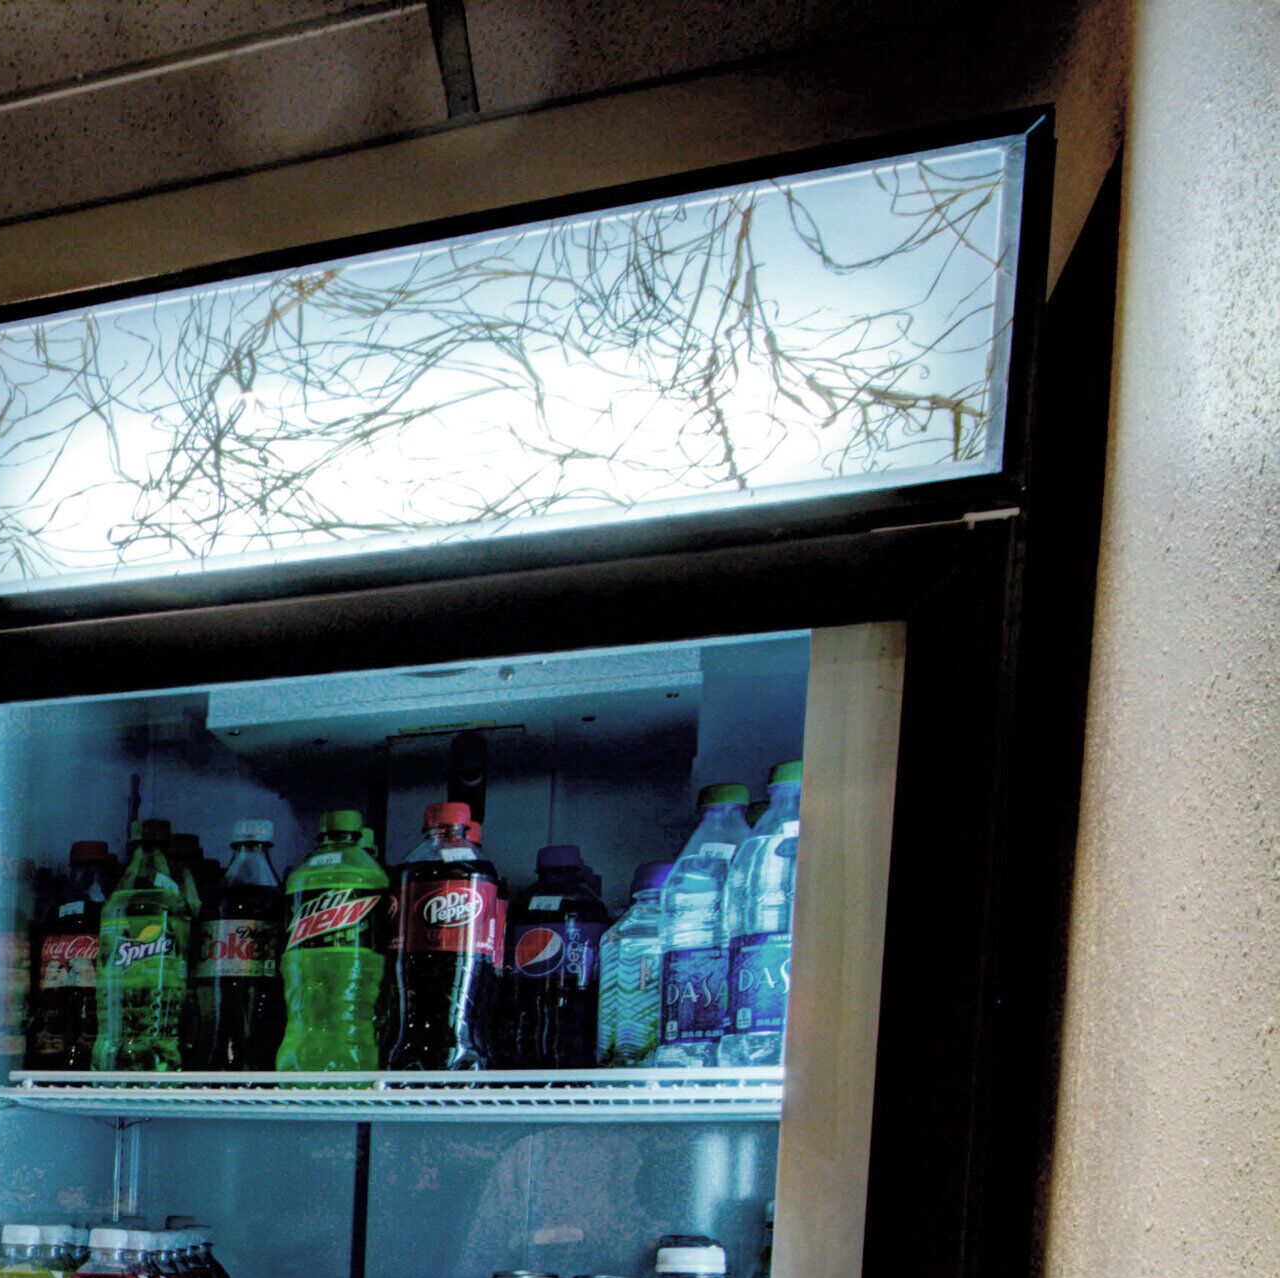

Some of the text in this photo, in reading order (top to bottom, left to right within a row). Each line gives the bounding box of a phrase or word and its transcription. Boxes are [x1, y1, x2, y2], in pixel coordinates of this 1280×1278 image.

[430, 897, 480, 924] Pepper
[446, 891, 469, 906] Dr
[114, 935, 175, 969] Sprite
[665, 973, 729, 1008] DASA
[738, 956, 791, 993] DAS
